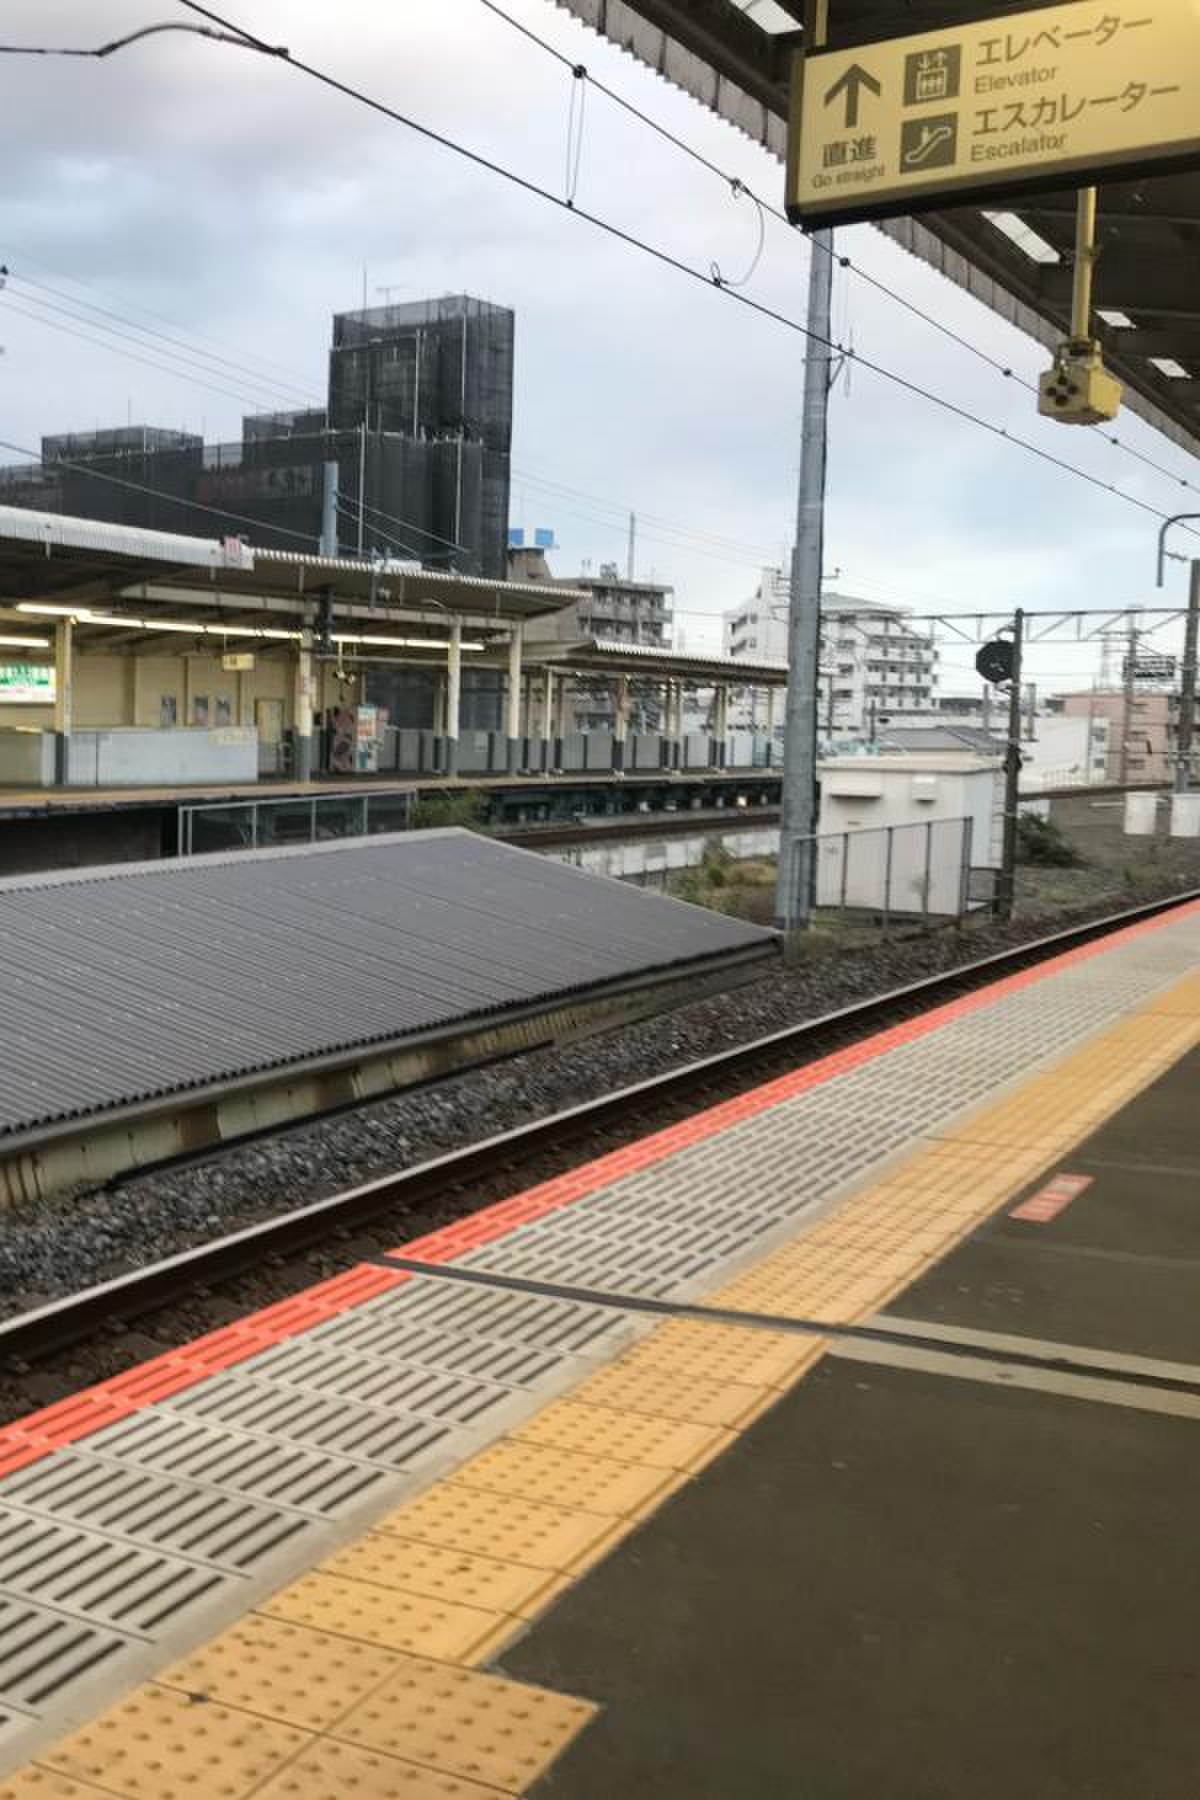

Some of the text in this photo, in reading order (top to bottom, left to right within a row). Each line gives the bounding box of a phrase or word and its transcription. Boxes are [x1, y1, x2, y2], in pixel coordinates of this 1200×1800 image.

[975, 13, 1153, 67] エレベーター
[974, 65, 1058, 94] Elevator
[971, 81, 1181, 136] エスカレーター
[822, 136, 877, 168] 直進
[970, 132, 1067, 163] Escalator
